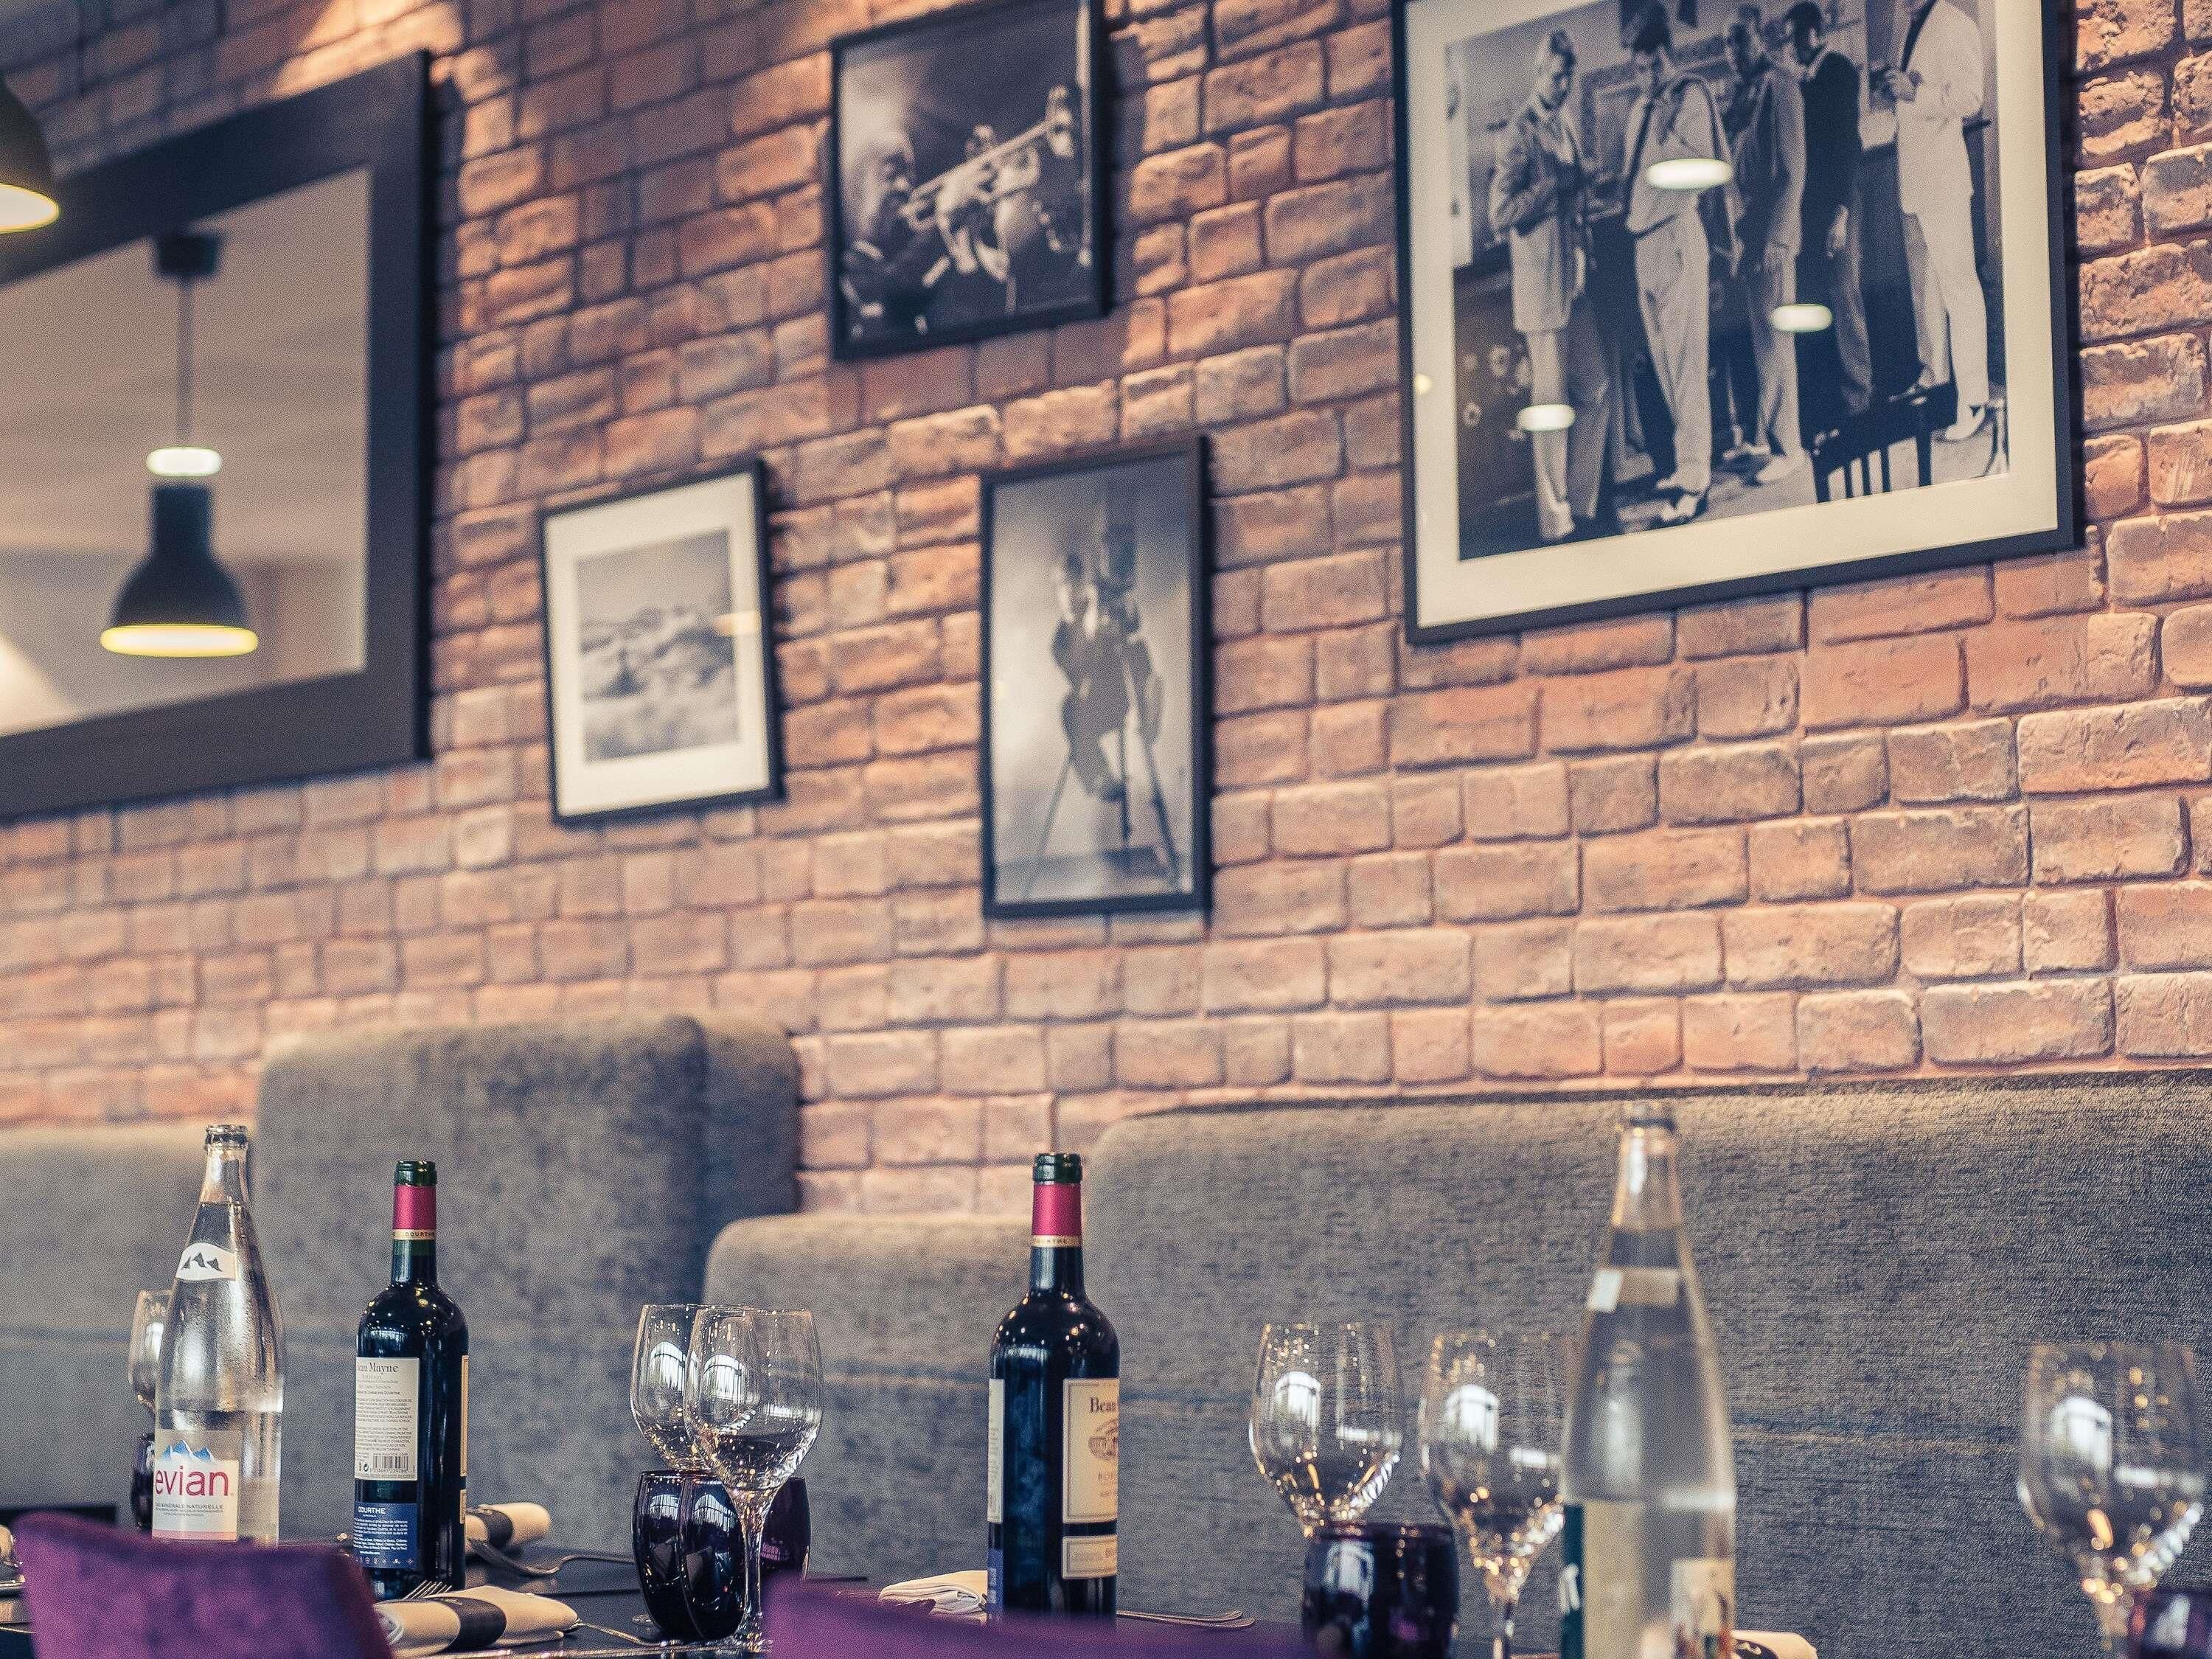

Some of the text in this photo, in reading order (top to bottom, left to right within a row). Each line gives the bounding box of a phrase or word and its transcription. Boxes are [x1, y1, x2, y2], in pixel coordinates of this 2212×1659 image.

[369, 1362, 399, 1375] Mayne
[1089, 1397, 1116, 1413] Beau
[155, 1465, 229, 1497] evian
[358, 1506, 386, 1514] DOURTHE
